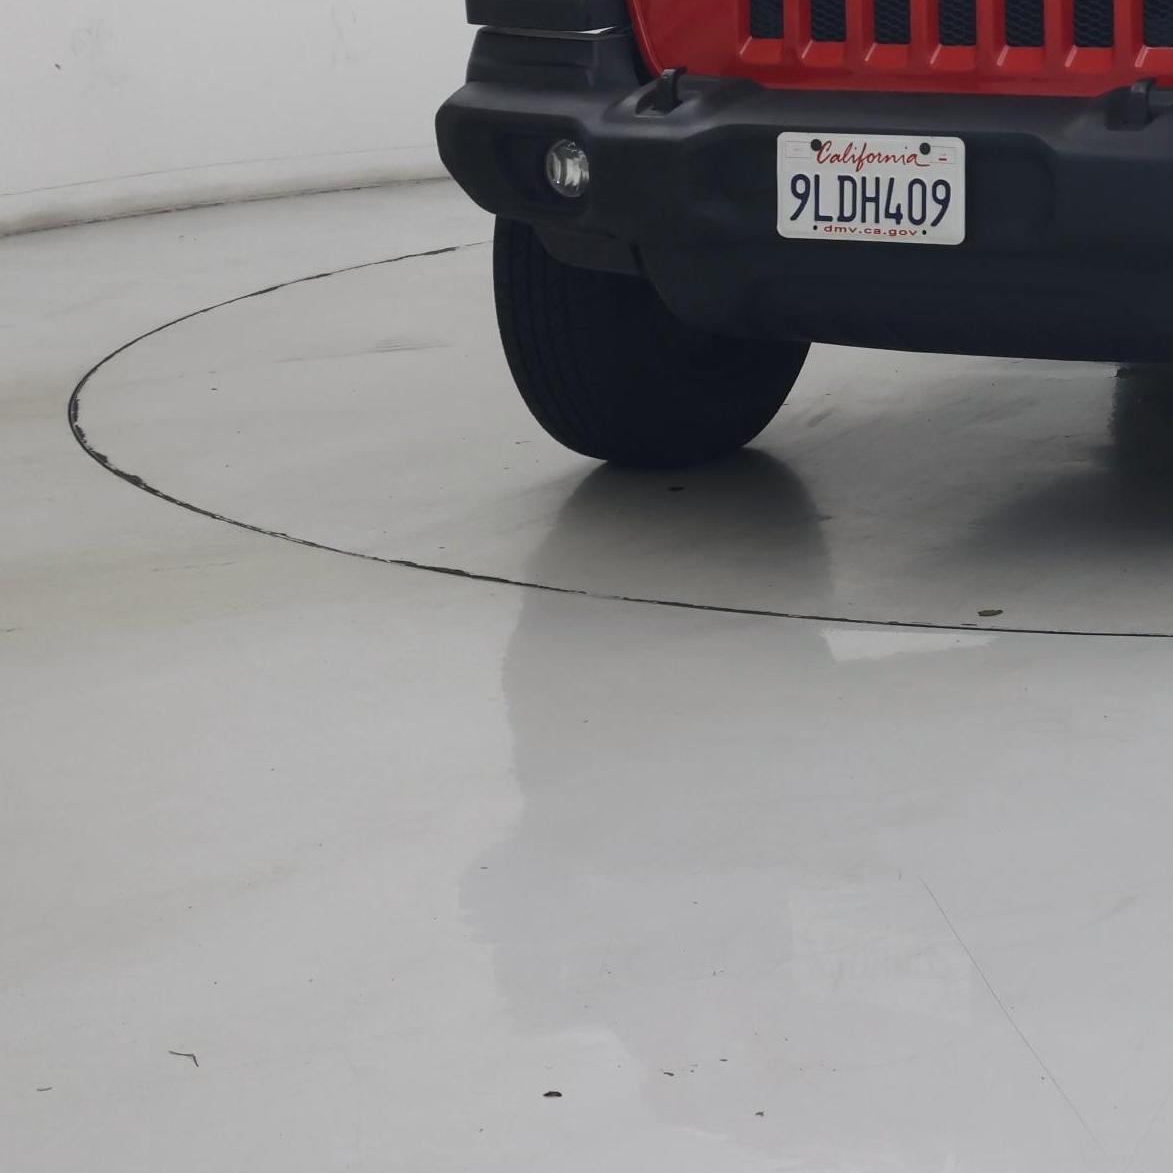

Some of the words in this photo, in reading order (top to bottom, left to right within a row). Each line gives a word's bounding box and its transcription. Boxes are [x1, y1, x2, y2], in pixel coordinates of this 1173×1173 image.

[816, 140, 930, 172] California
[789, 173, 952, 227] 9LDH409
[823, 224, 918, 237] dmv.ca.gov
